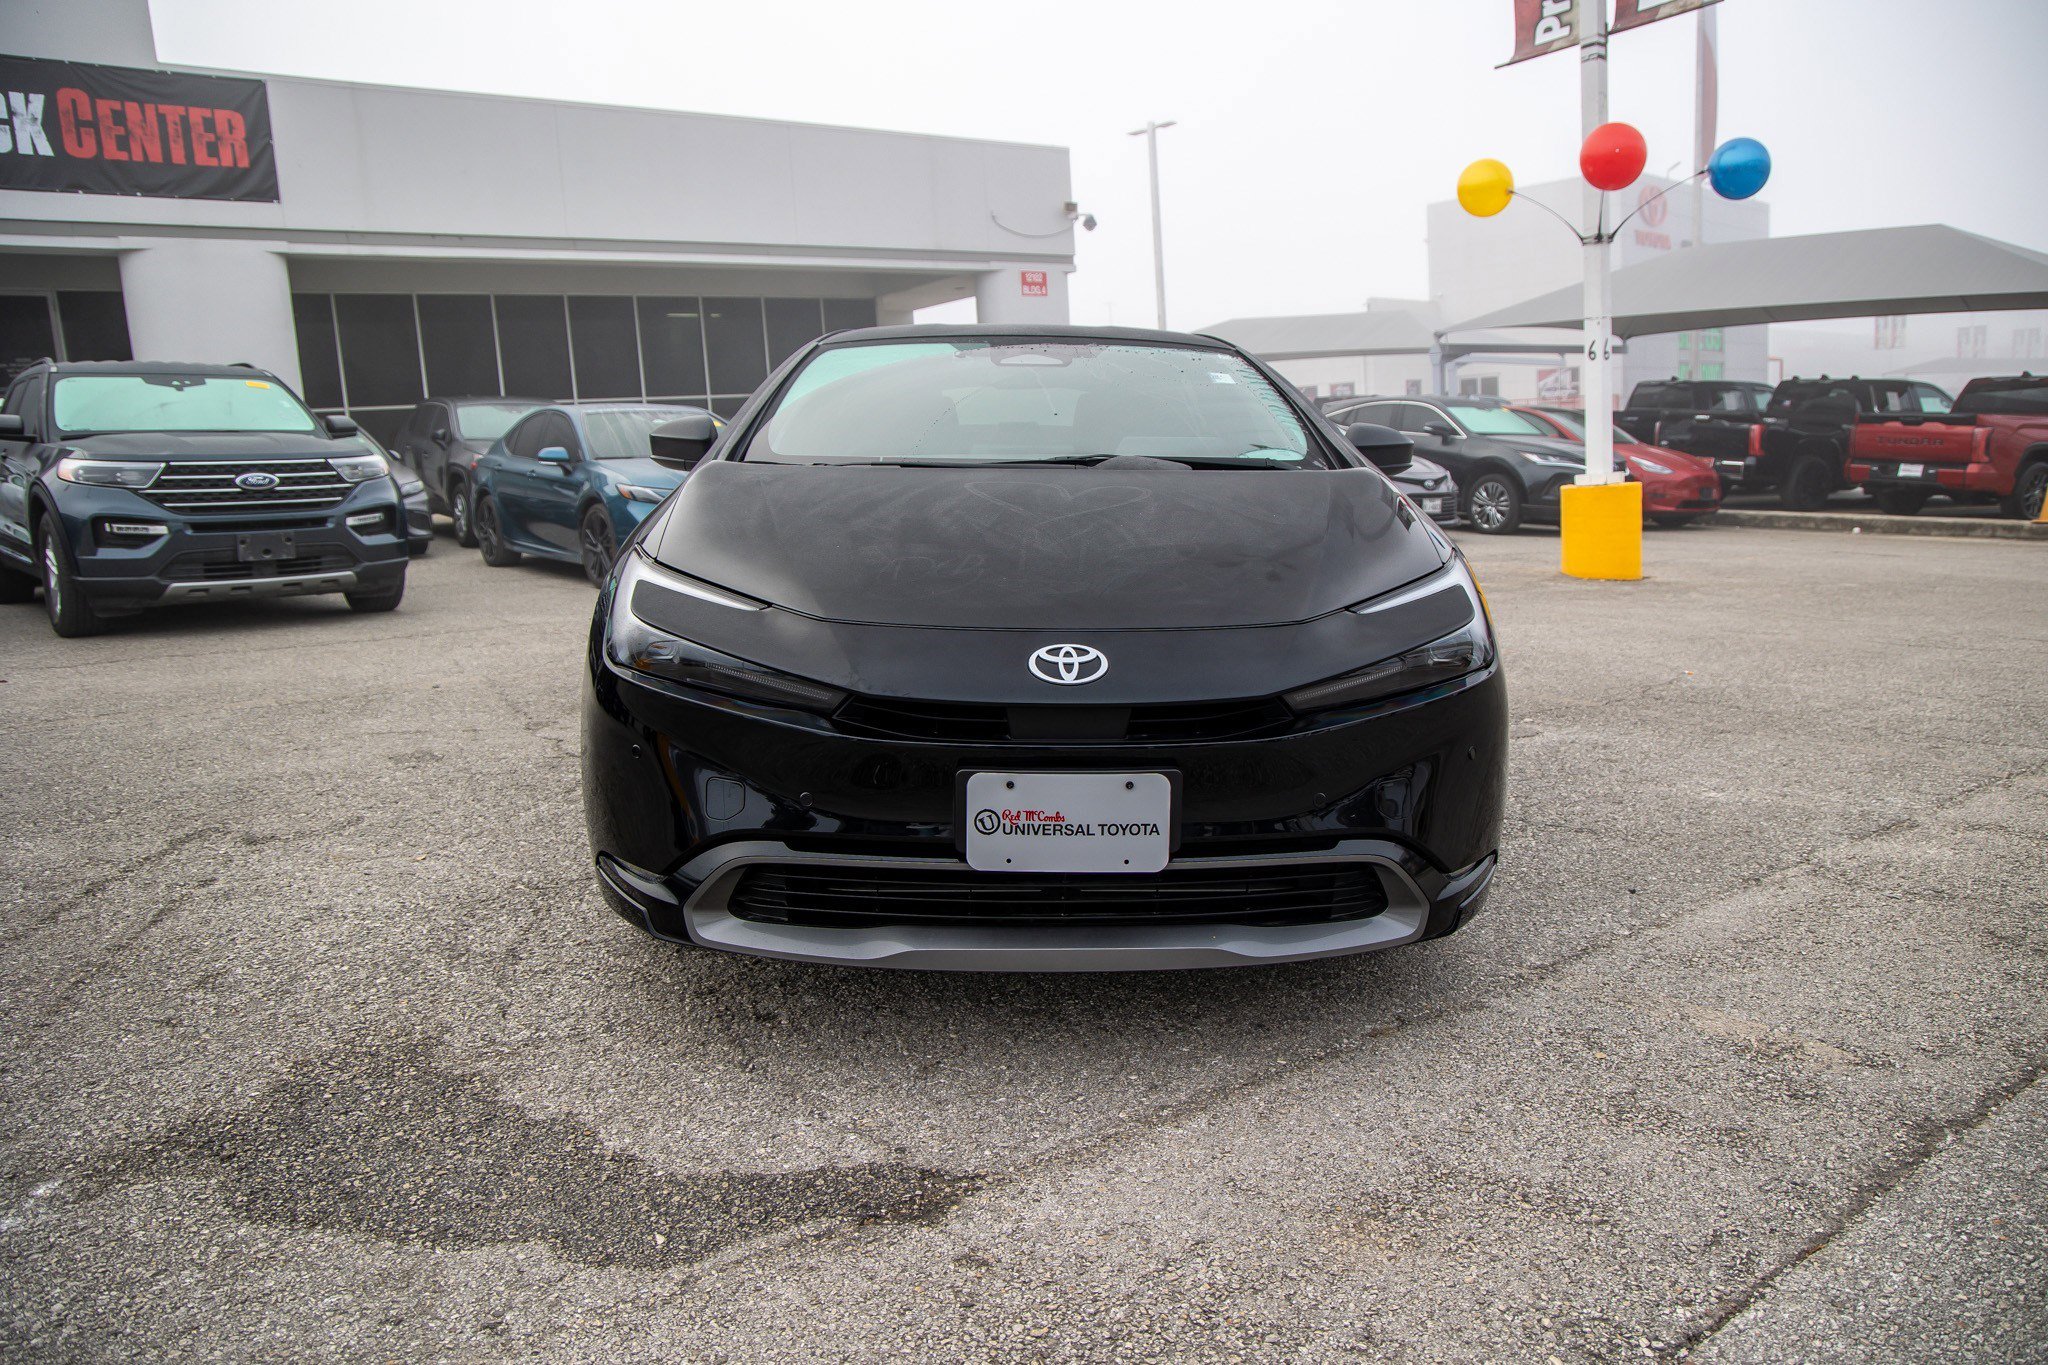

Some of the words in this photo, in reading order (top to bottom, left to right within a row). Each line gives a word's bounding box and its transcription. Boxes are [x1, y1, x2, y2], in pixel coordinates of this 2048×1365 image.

[56, 87, 249, 168] CENTER
[1002, 808, 1021, 826] Red
[1022, 809, 1066, 823] McCombs
[1002, 822, 1096, 836] UNIVERSAL
[1098, 823, 1160, 836] TOYOTA
